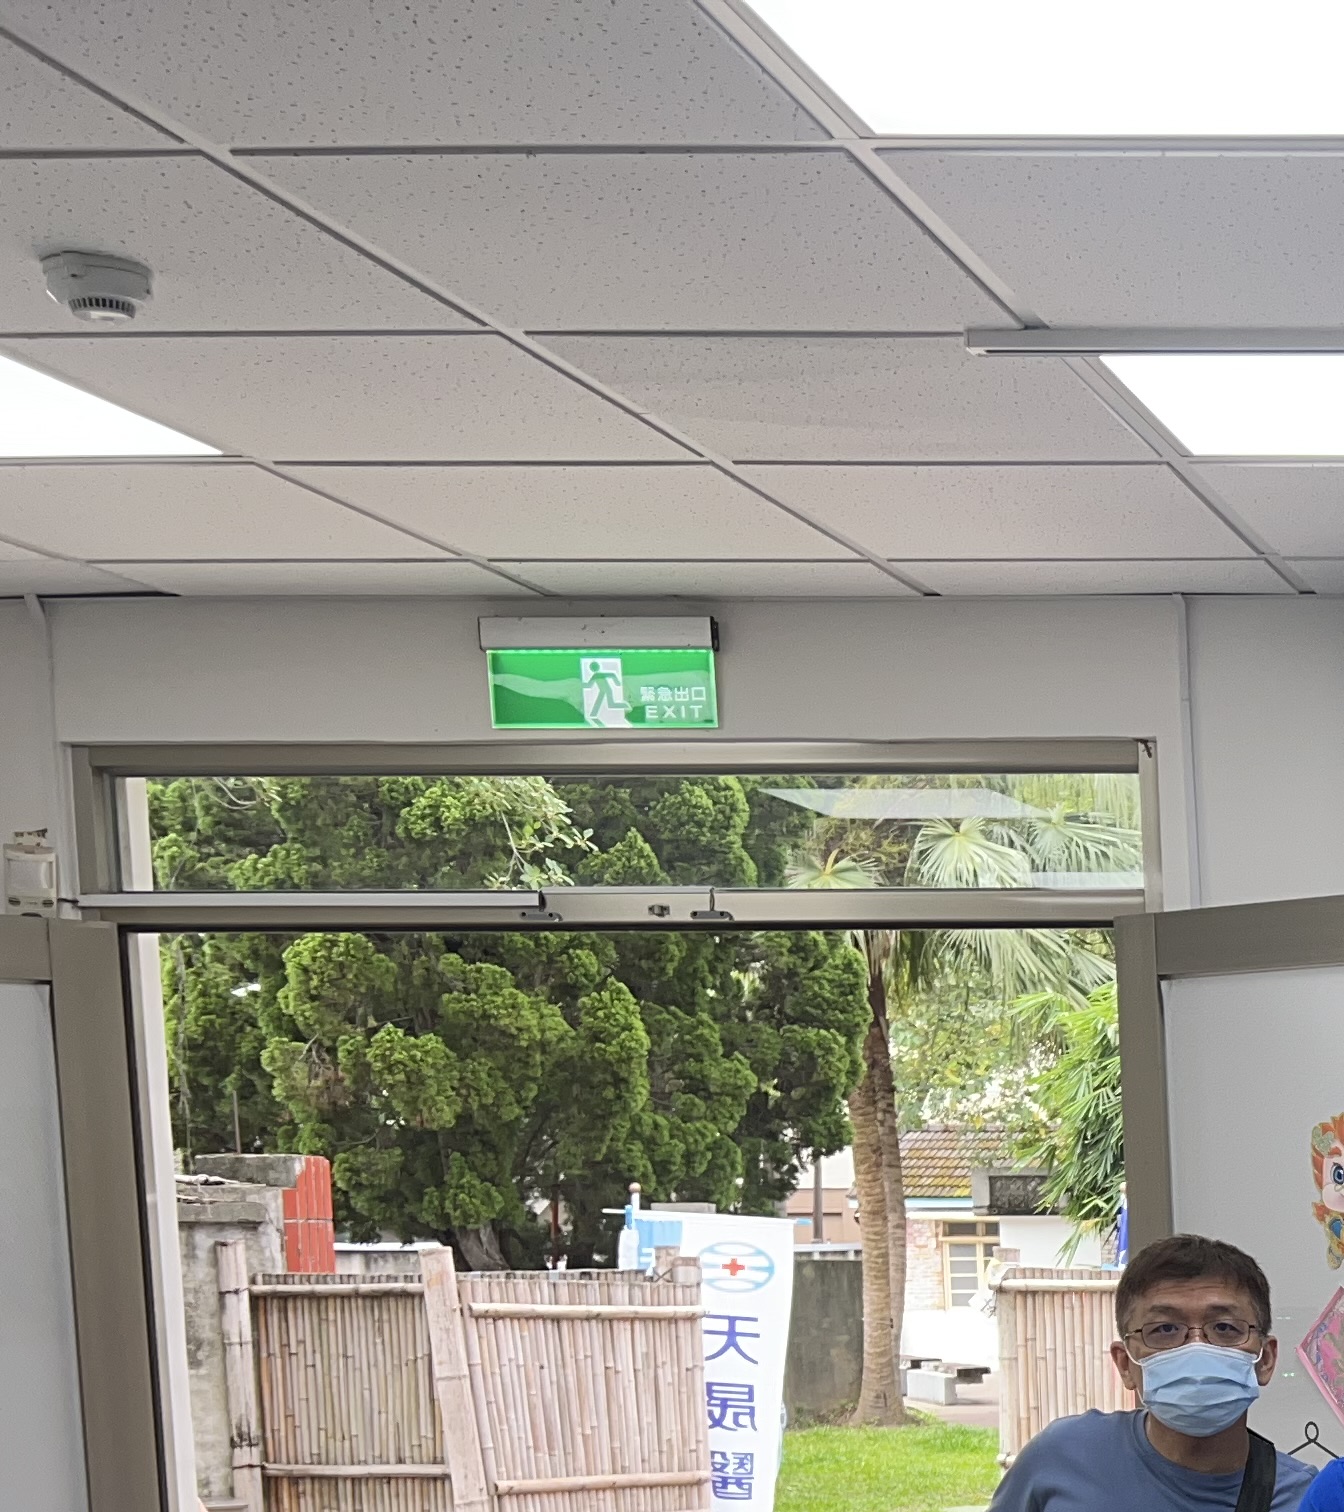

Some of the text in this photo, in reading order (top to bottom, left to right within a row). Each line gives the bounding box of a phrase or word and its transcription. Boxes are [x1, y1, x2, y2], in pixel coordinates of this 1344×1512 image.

[640, 686, 706, 701] 緊急出口
[645, 705, 703, 719] EXIT
